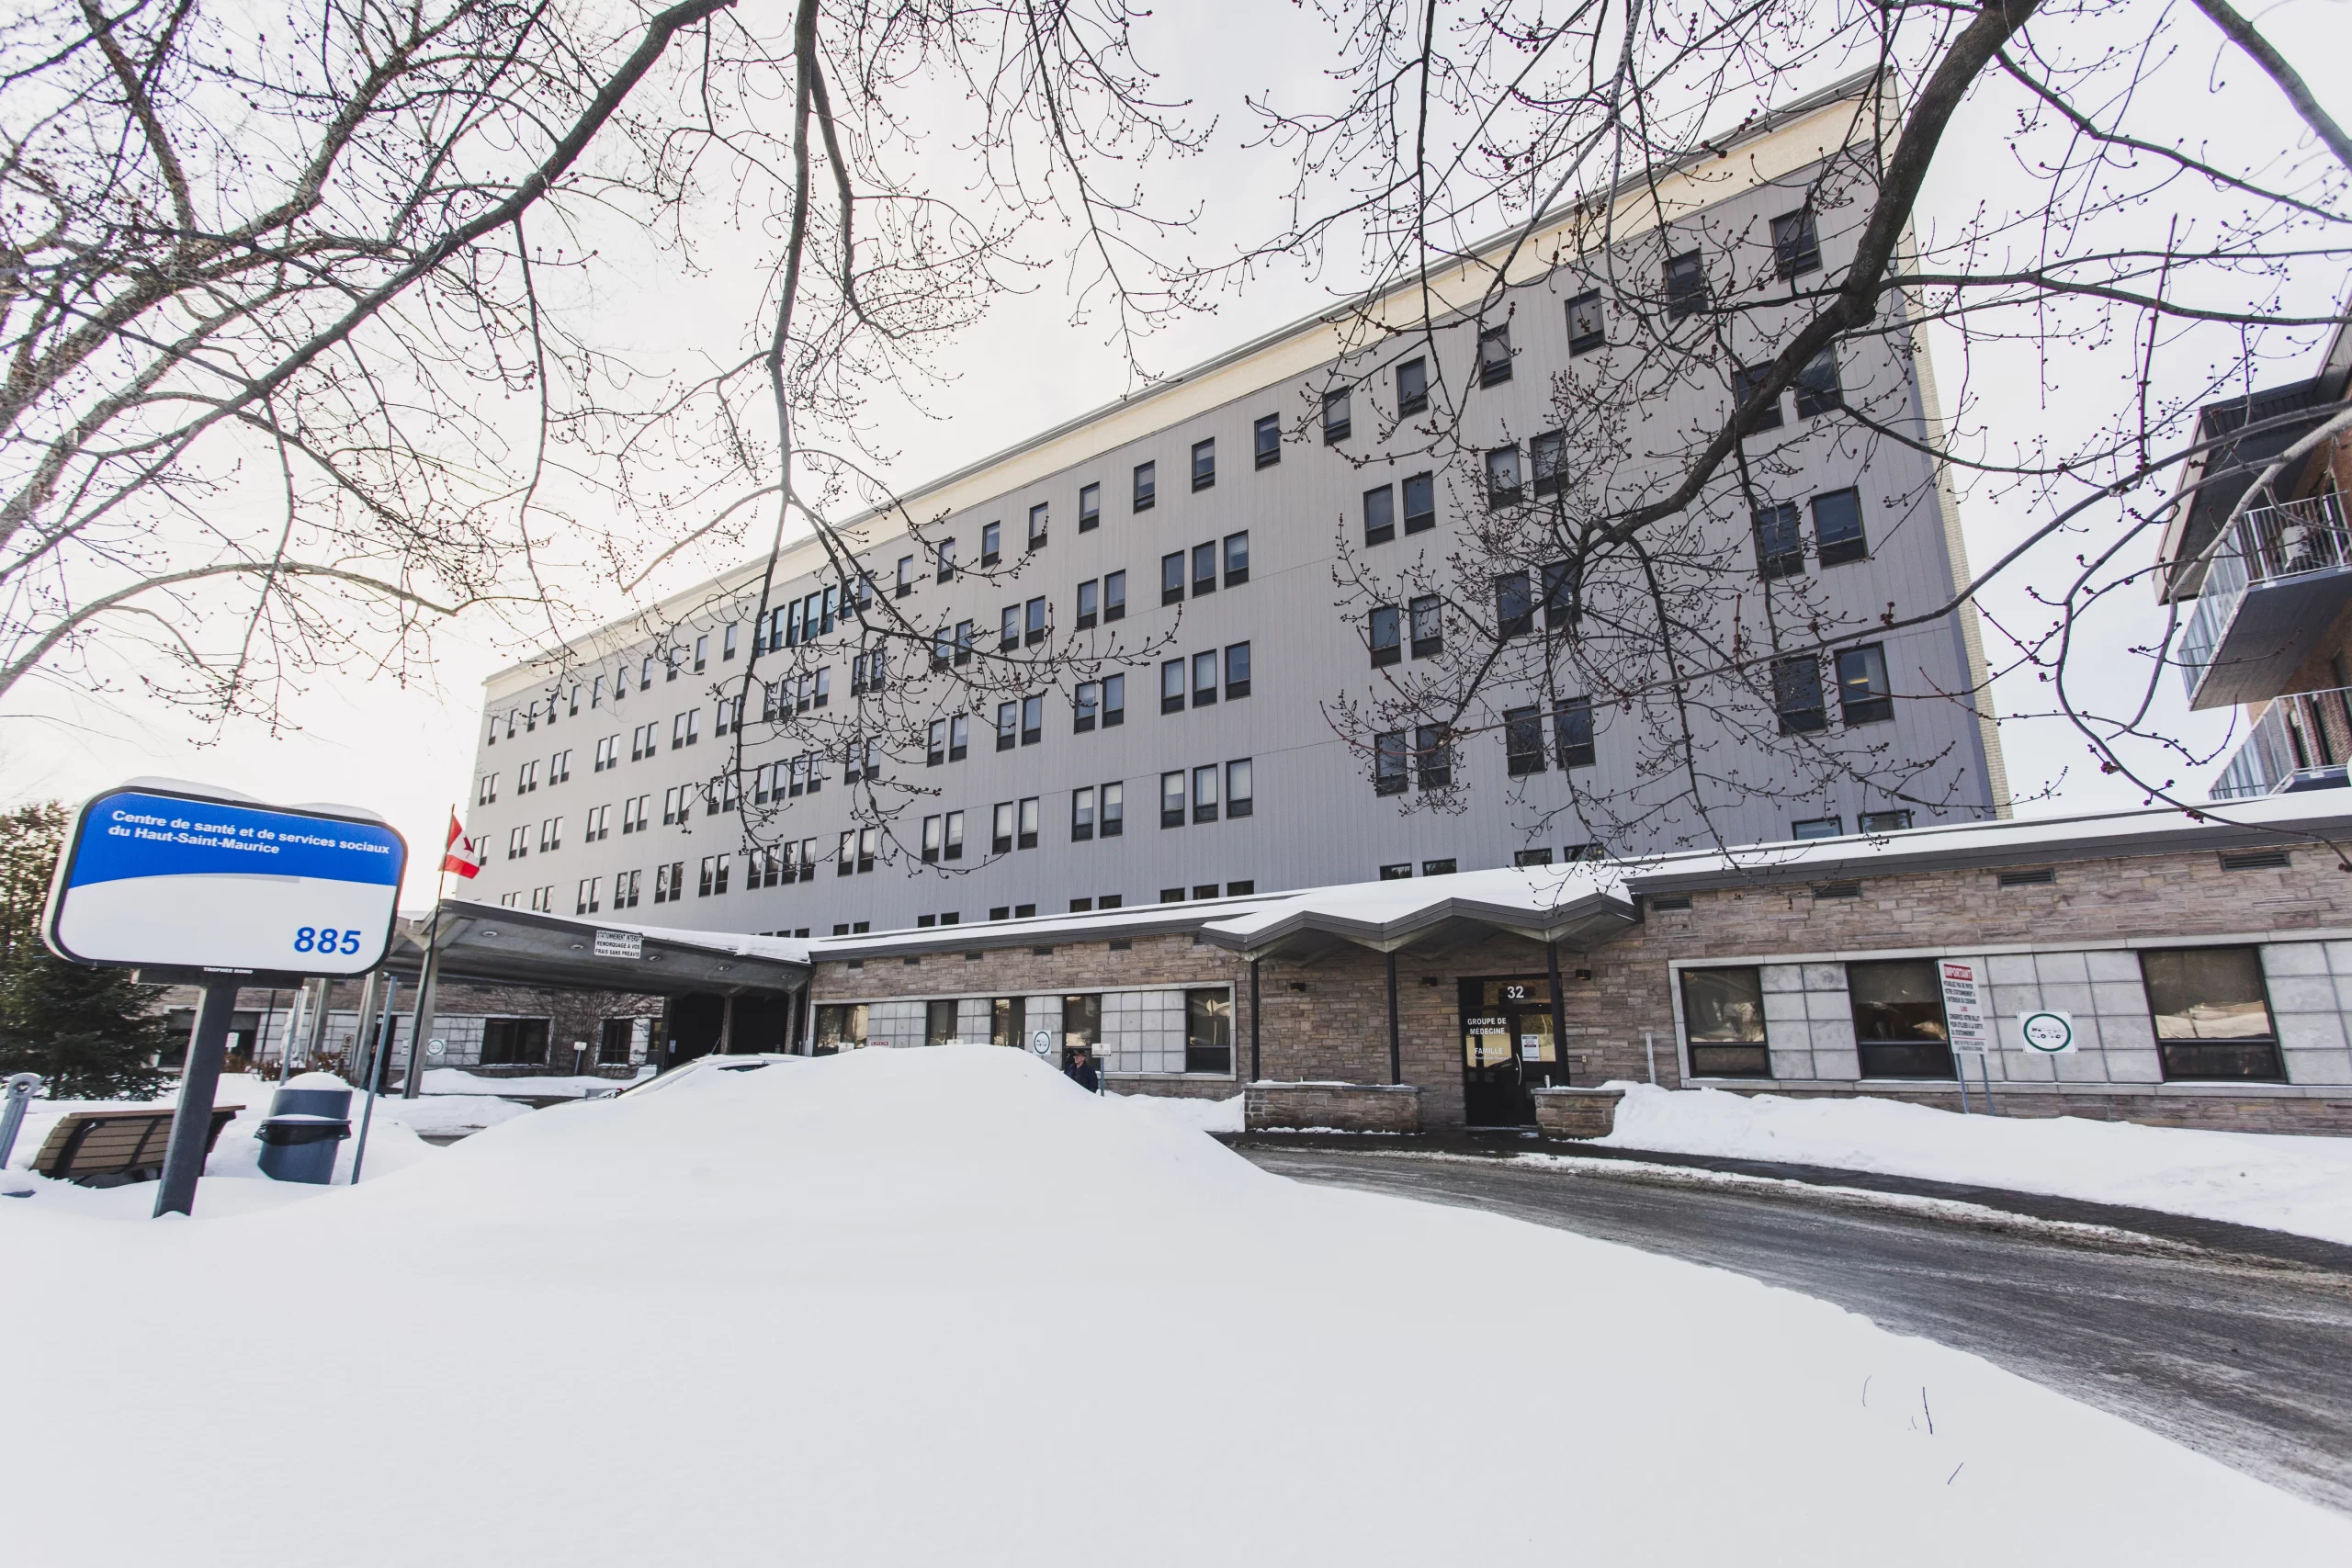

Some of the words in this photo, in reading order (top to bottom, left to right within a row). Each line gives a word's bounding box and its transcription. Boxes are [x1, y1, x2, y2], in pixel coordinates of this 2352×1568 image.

[111, 809, 167, 827] Centre
[170, 818, 190, 829] de
[194, 821, 236, 835] santé
[239, 827, 254, 838] et
[256, 829, 275, 840] de
[278, 832, 336, 848] services
[339, 840, 390, 854] sociaux
[107, 825, 130, 837] du
[134, 827, 280, 854] Haut-Saint-Maurice
[293, 926, 361, 955] 885
[597, 931, 626, 941] STATIONNEMENT
[597, 941, 627, 949] REMORQUAGE
[1944, 966, 1973, 979] IMPORTANT
[1507, 986, 1524, 998] 32
[1466, 1017, 1496, 1026] GROUPE
[1497, 1017, 1507, 1025] DE
[1469, 1027, 1506, 1035] MÉDECINE
